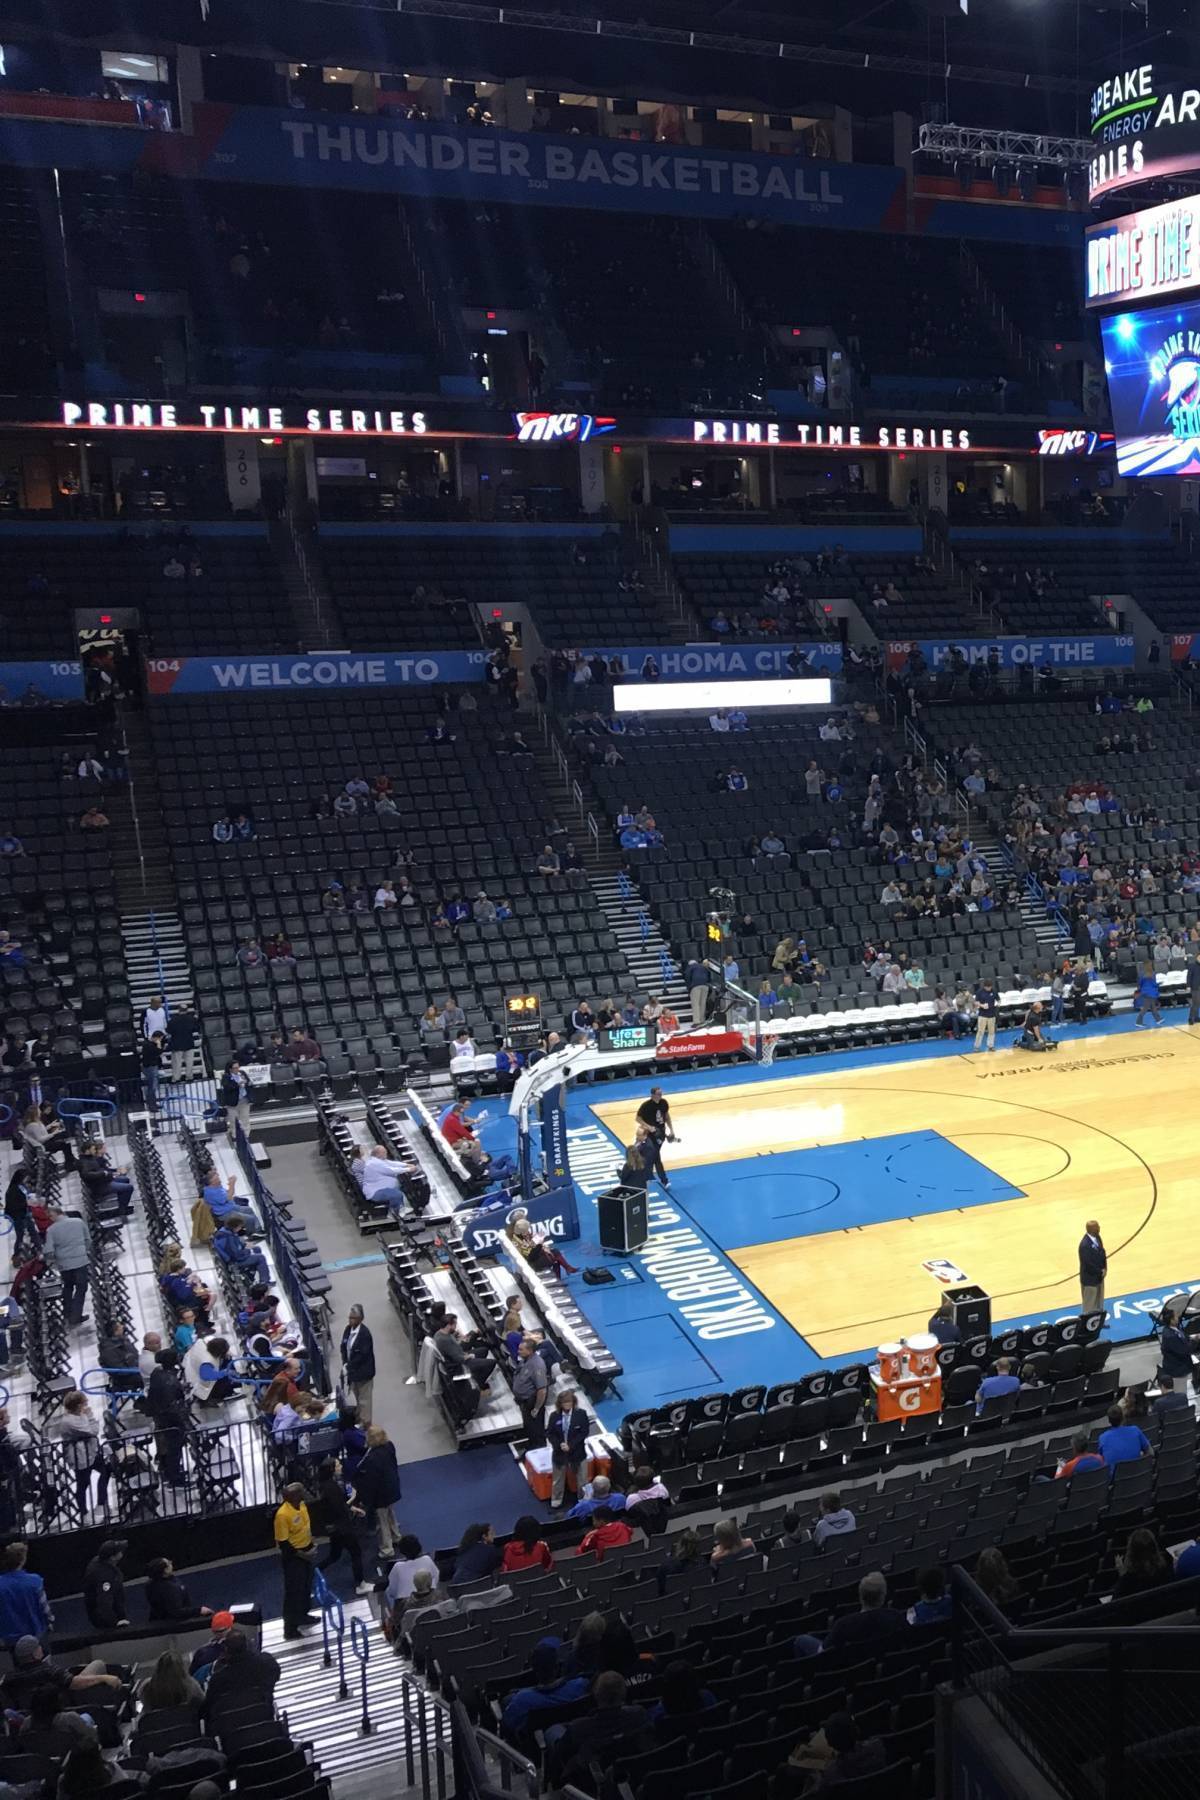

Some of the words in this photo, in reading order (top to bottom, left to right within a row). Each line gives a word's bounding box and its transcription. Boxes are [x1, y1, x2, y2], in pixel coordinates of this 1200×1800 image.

[1103, 110, 1153, 145] ENERGY
[280, 120, 531, 177] THUNDER
[545, 144, 844, 205] BASKETBALL
[1088, 227, 1142, 297] PRIME
[1148, 212, 1194, 286] TIME
[63, 402, 177, 429] PRIME
[200, 405, 285, 431] TIME
[305, 408, 428, 434] SERIES
[694, 421, 780, 443] PRIME
[799, 424, 862, 446] TIME
[879, 427, 972, 450] SERIES
[237, 448, 248, 488] 206
[1114, 635, 1135, 648] 106
[1174, 634, 1192, 646] 107
[819, 643, 841, 656] 105
[1011, 642, 1044, 664] OF
[1048, 641, 1095, 662] THE
[49, 662, 81, 676] 103
[149, 659, 181, 675] 104
[212, 661, 386, 689] WELCOME
[395, 658, 440, 683] TO
[608, 1029, 632, 1042] Life
[612, 1037, 647, 1050] Share
[668, 1042, 706, 1055] StateFarm
[1056, 1051, 1176, 1074] CHESAPEAKE
[975, 1064, 1045, 1080] ARENA
[552, 1108, 563, 1166] DRAFTKINGS
[634, 1226, 776, 1342] OKLAHOMA
[1061, 1323, 1078, 1341] G
[1087, 1315, 1102, 1333] G
[1002, 1333, 1019, 1352] G
[1032, 1329, 1049, 1347] G
[939, 1348, 956, 1366] G
[970, 1342, 987, 1360] G
[809, 1377, 827, 1395] G
[842, 1370, 861, 1388] G
[741, 1393, 758, 1410] G
[779, 1389, 797, 1405] G
[900, 1388, 921, 1412] G
[670, 1406, 688, 1424] G
[704, 1400, 723, 1418] G
[635, 1415, 652, 1433] G
